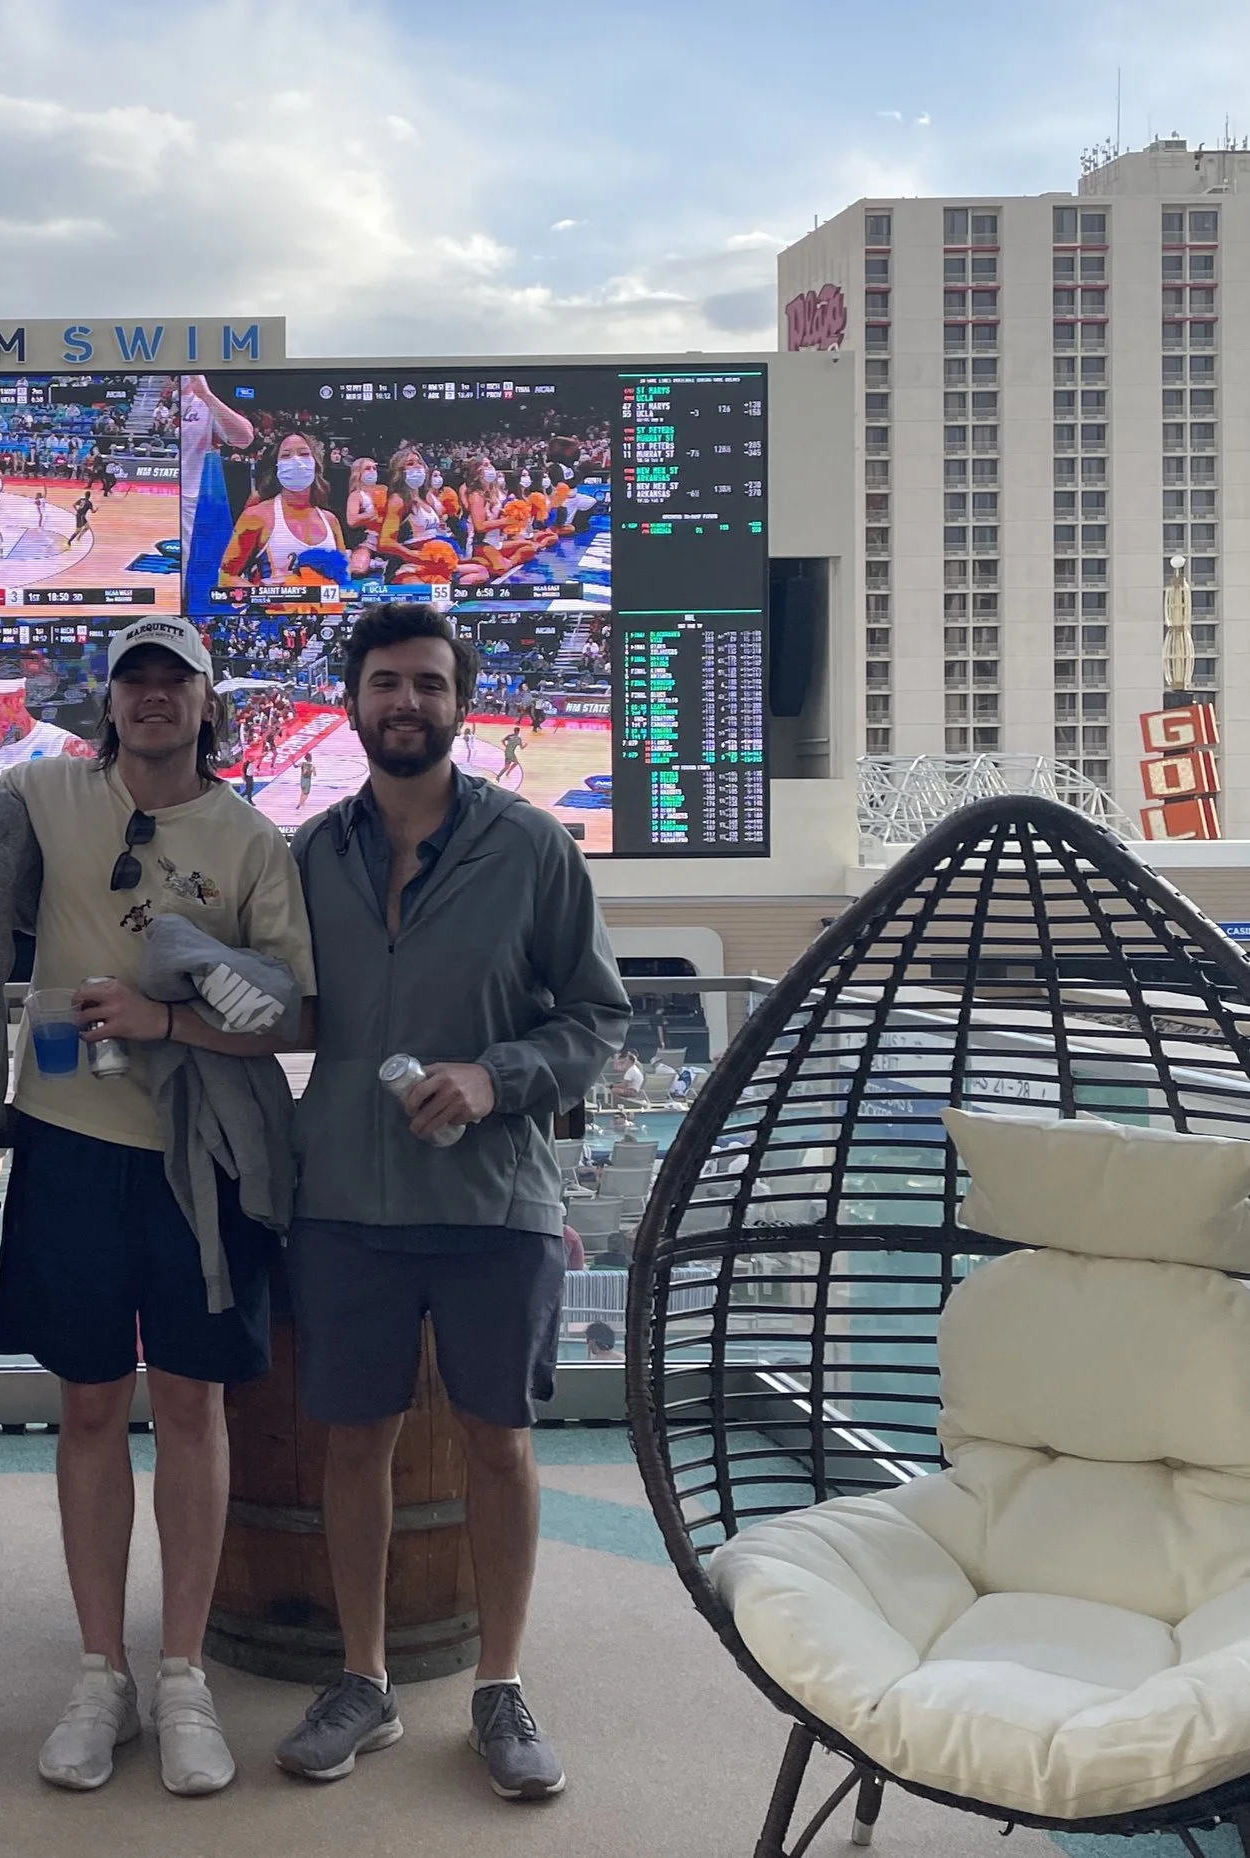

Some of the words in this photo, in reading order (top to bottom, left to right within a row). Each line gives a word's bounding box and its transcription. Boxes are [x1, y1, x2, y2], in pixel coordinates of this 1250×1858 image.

[62, 324, 261, 363] SWIM
[718, 405, 731, 413] 126
[622, 410, 632, 418] 55
[636, 410, 654, 418] UCLA
[665, 434, 675, 442] ST
[622, 450, 631, 458] 11
[636, 450, 662, 458] MURRAY
[665, 450, 675, 458] ST
[153, 468, 180, 478] STATE
[636, 474, 671, 482] ARKANSAS
[636, 482, 650, 490] NEW
[653, 482, 666, 490] MEX
[669, 482, 679, 490] ST
[636, 490, 671, 498] ARKANSAS
[259, 587, 279, 595] SAINT
[281, 587, 307, 595] MARY'S
[323, 588, 337, 599] 47
[434, 587, 448, 598] 55
[476, 589, 494, 597] 6:58
[500, 589, 510, 597] 26
[11, 591, 18, 602] 3
[47, 593, 69, 601] 18:50
[211, 591, 227, 600] tbs
[126, 623, 185, 640] MARQUETTE
[582, 703, 610, 713] STATE
[201, 962, 285, 1034] NIKE
